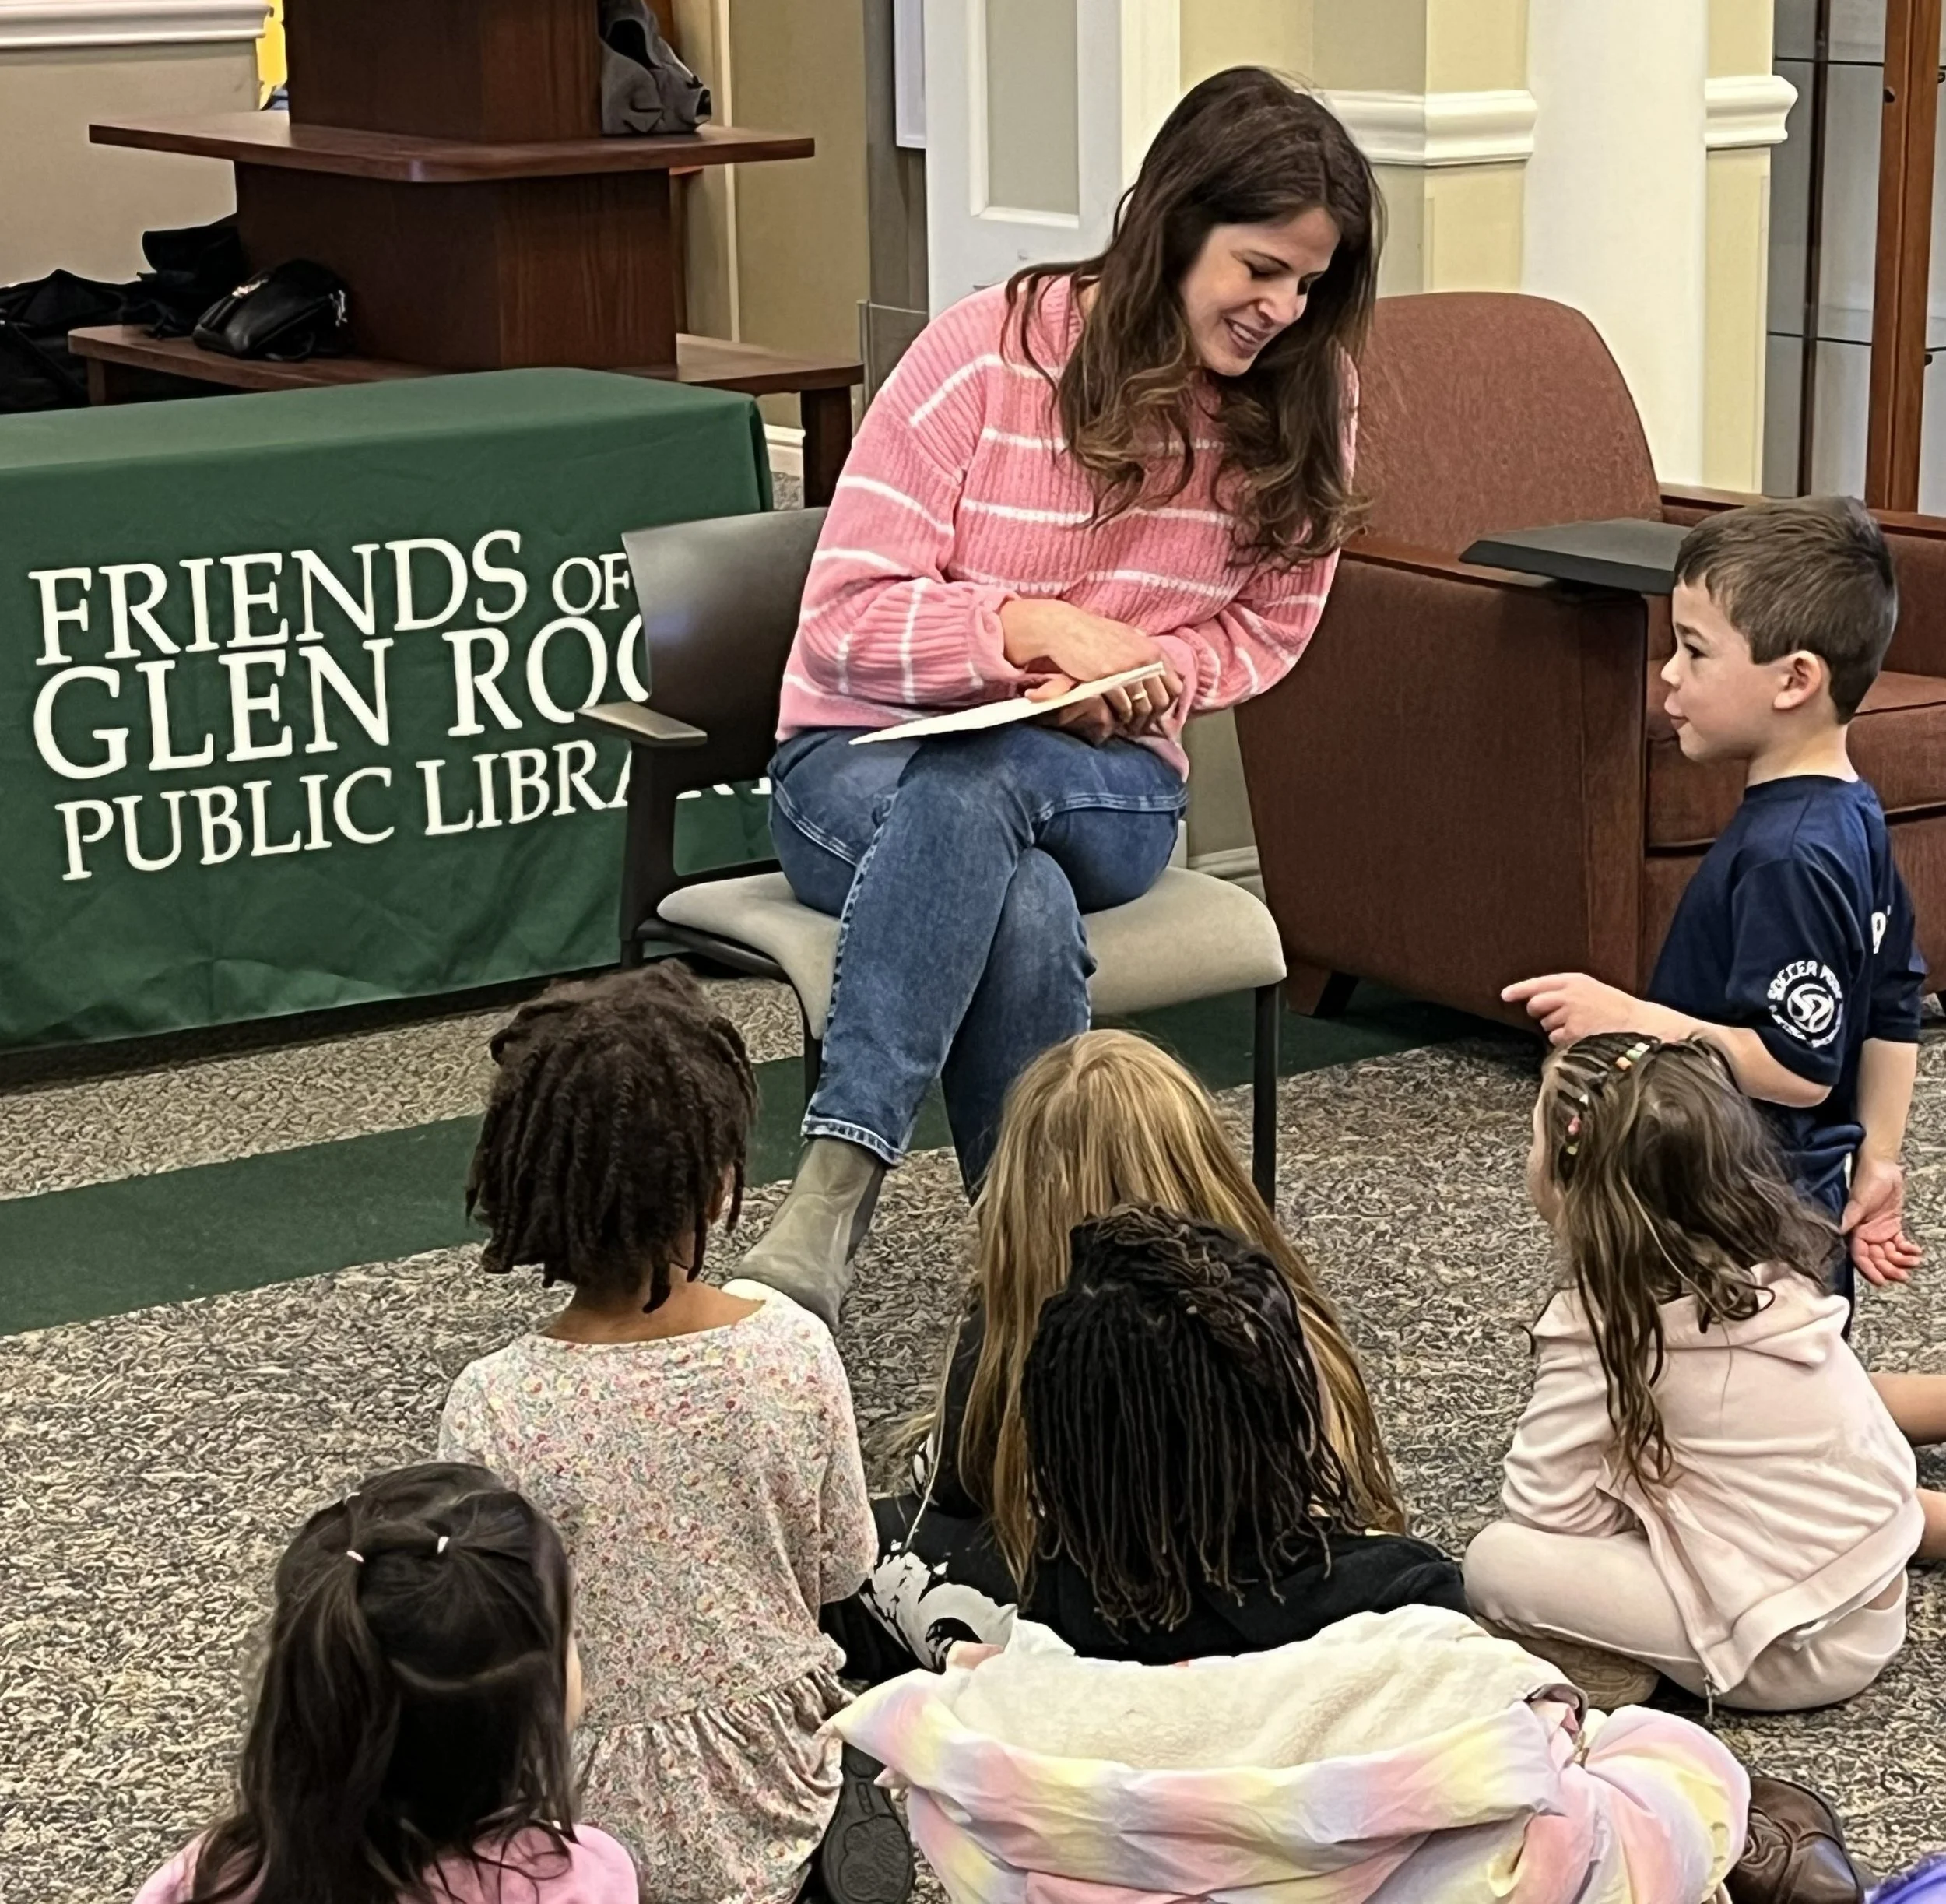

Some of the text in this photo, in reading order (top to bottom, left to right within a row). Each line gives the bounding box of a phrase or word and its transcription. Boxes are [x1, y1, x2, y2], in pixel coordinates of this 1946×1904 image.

[28, 530, 630, 665] FRIENDS OF
[34, 613, 650, 778] GLEN ROC
[55, 739, 771, 881] PUBLIC LIBR
